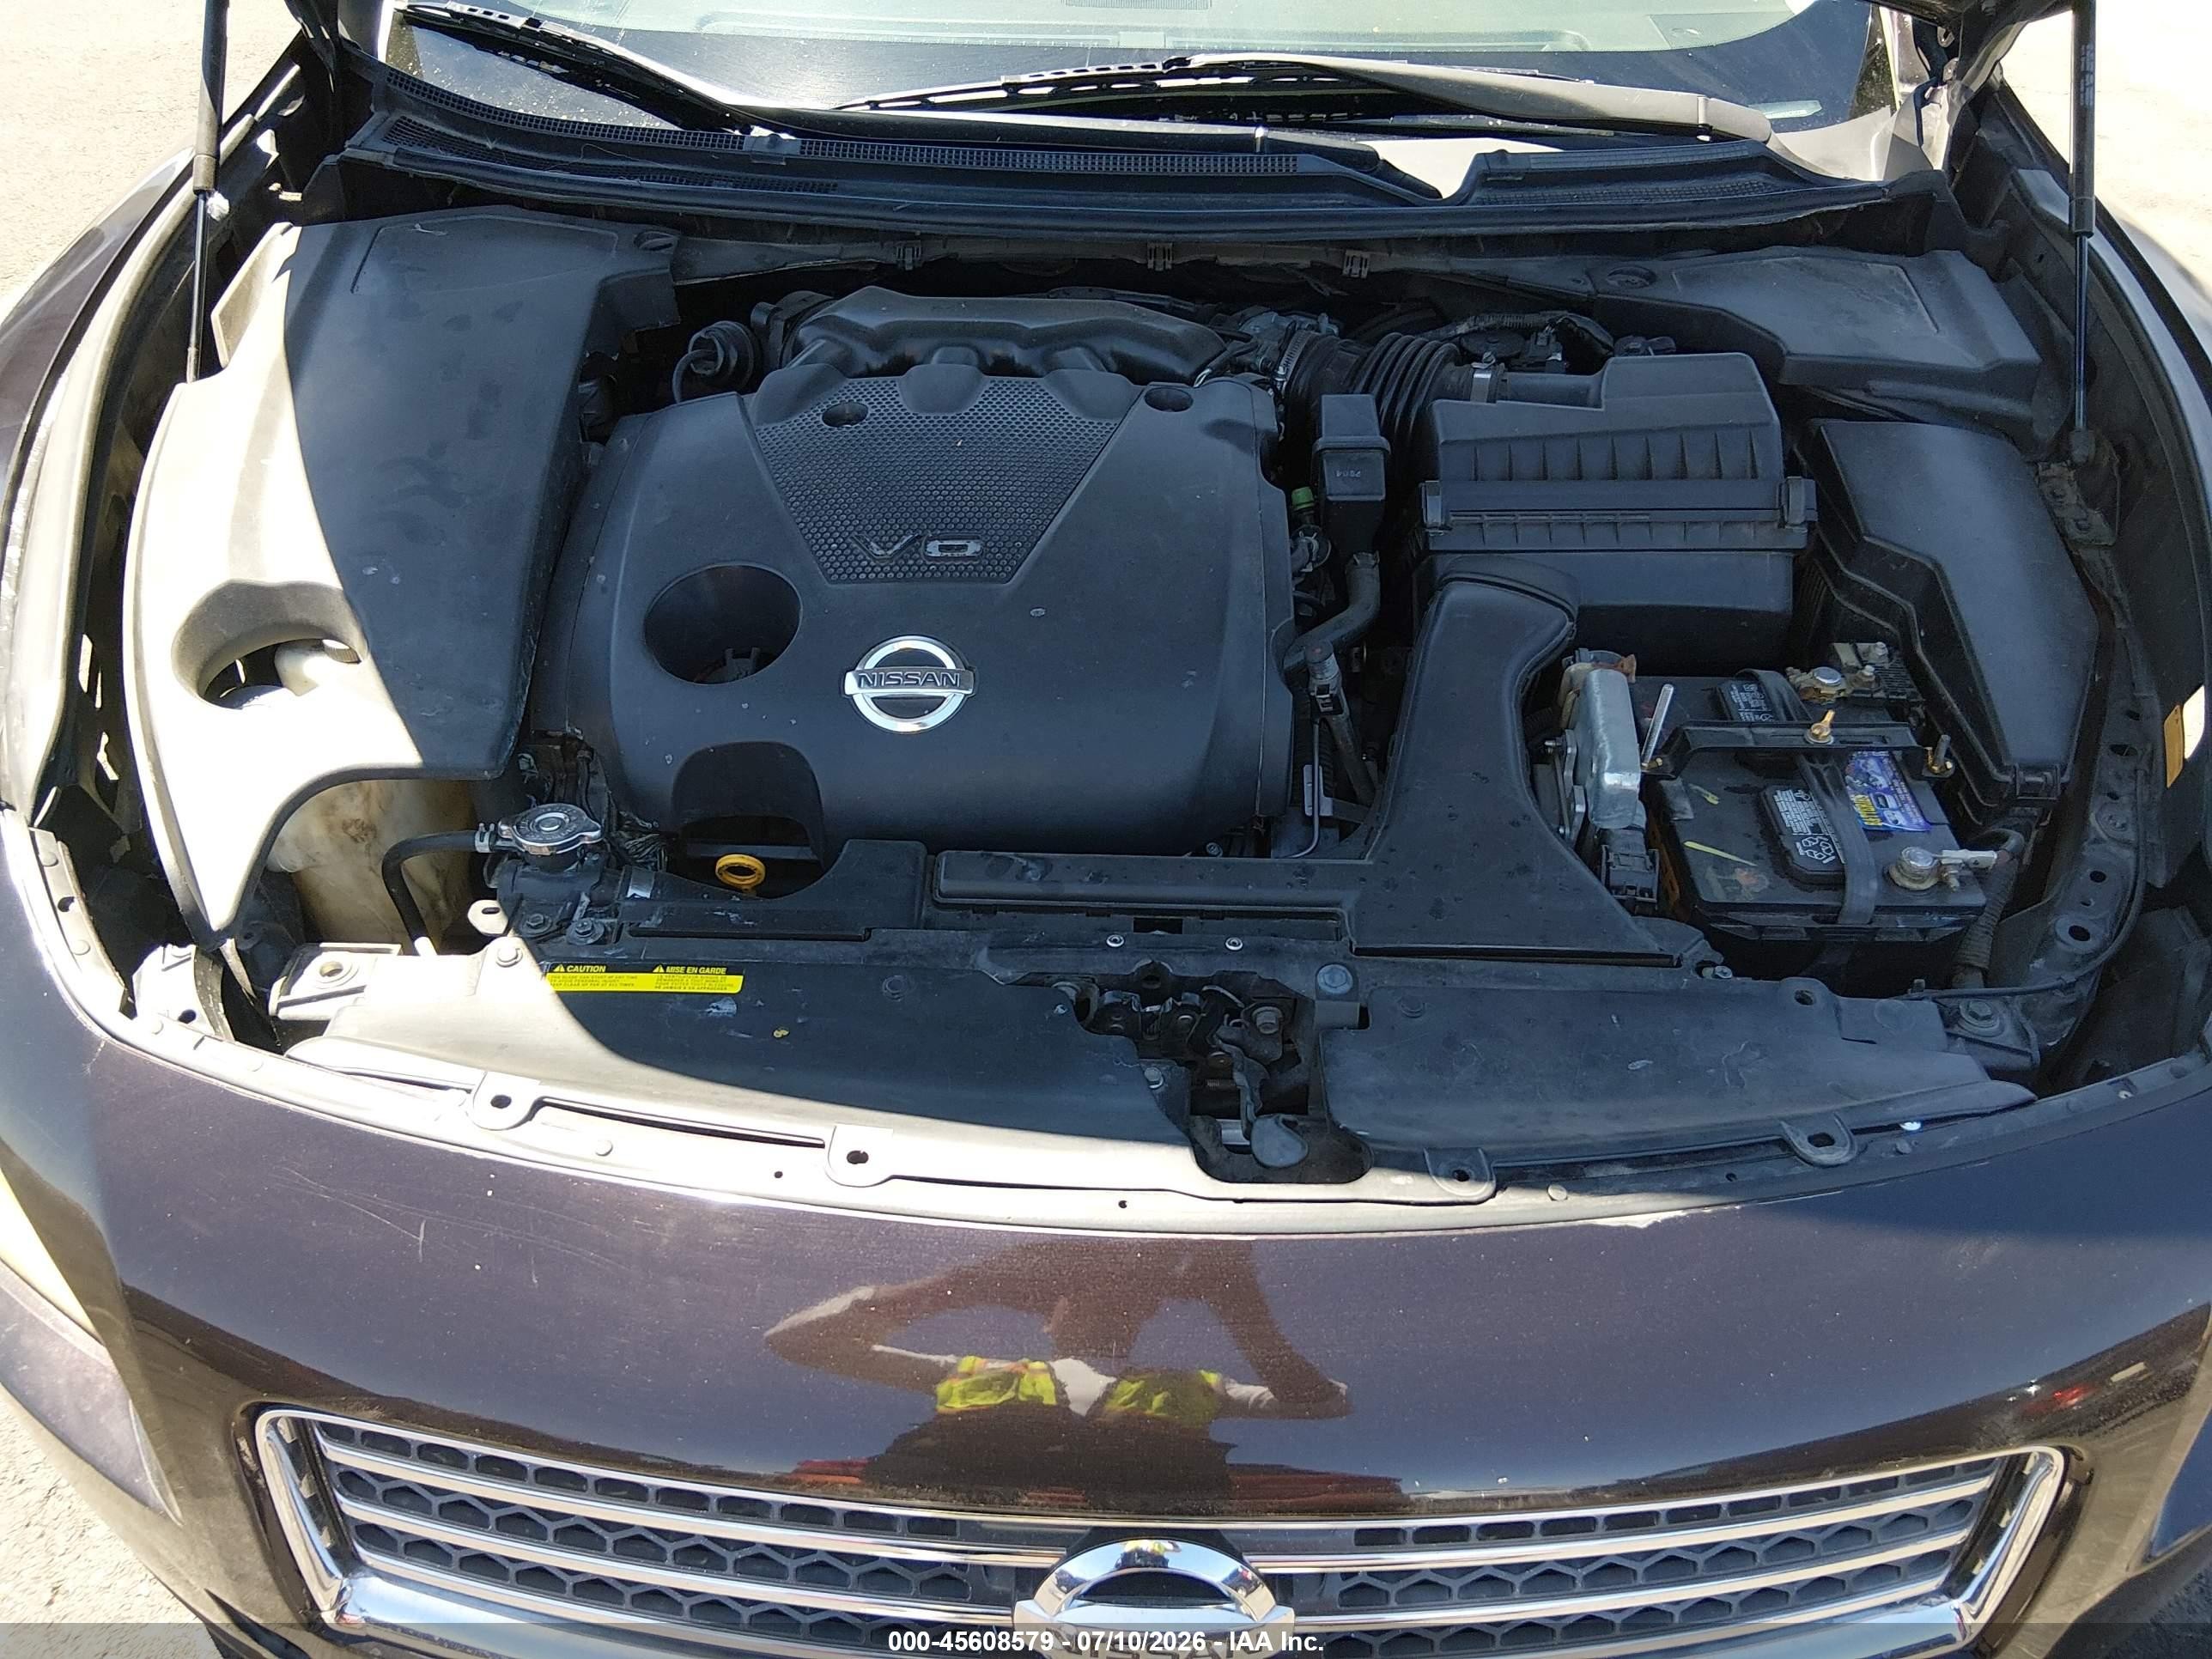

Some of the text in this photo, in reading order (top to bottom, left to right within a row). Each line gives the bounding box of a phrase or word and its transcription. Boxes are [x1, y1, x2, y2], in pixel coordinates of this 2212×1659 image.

[857, 672, 961, 688] NISSAN
[567, 964, 607, 973] CAUTION
[665, 965, 686, 974] MISE
